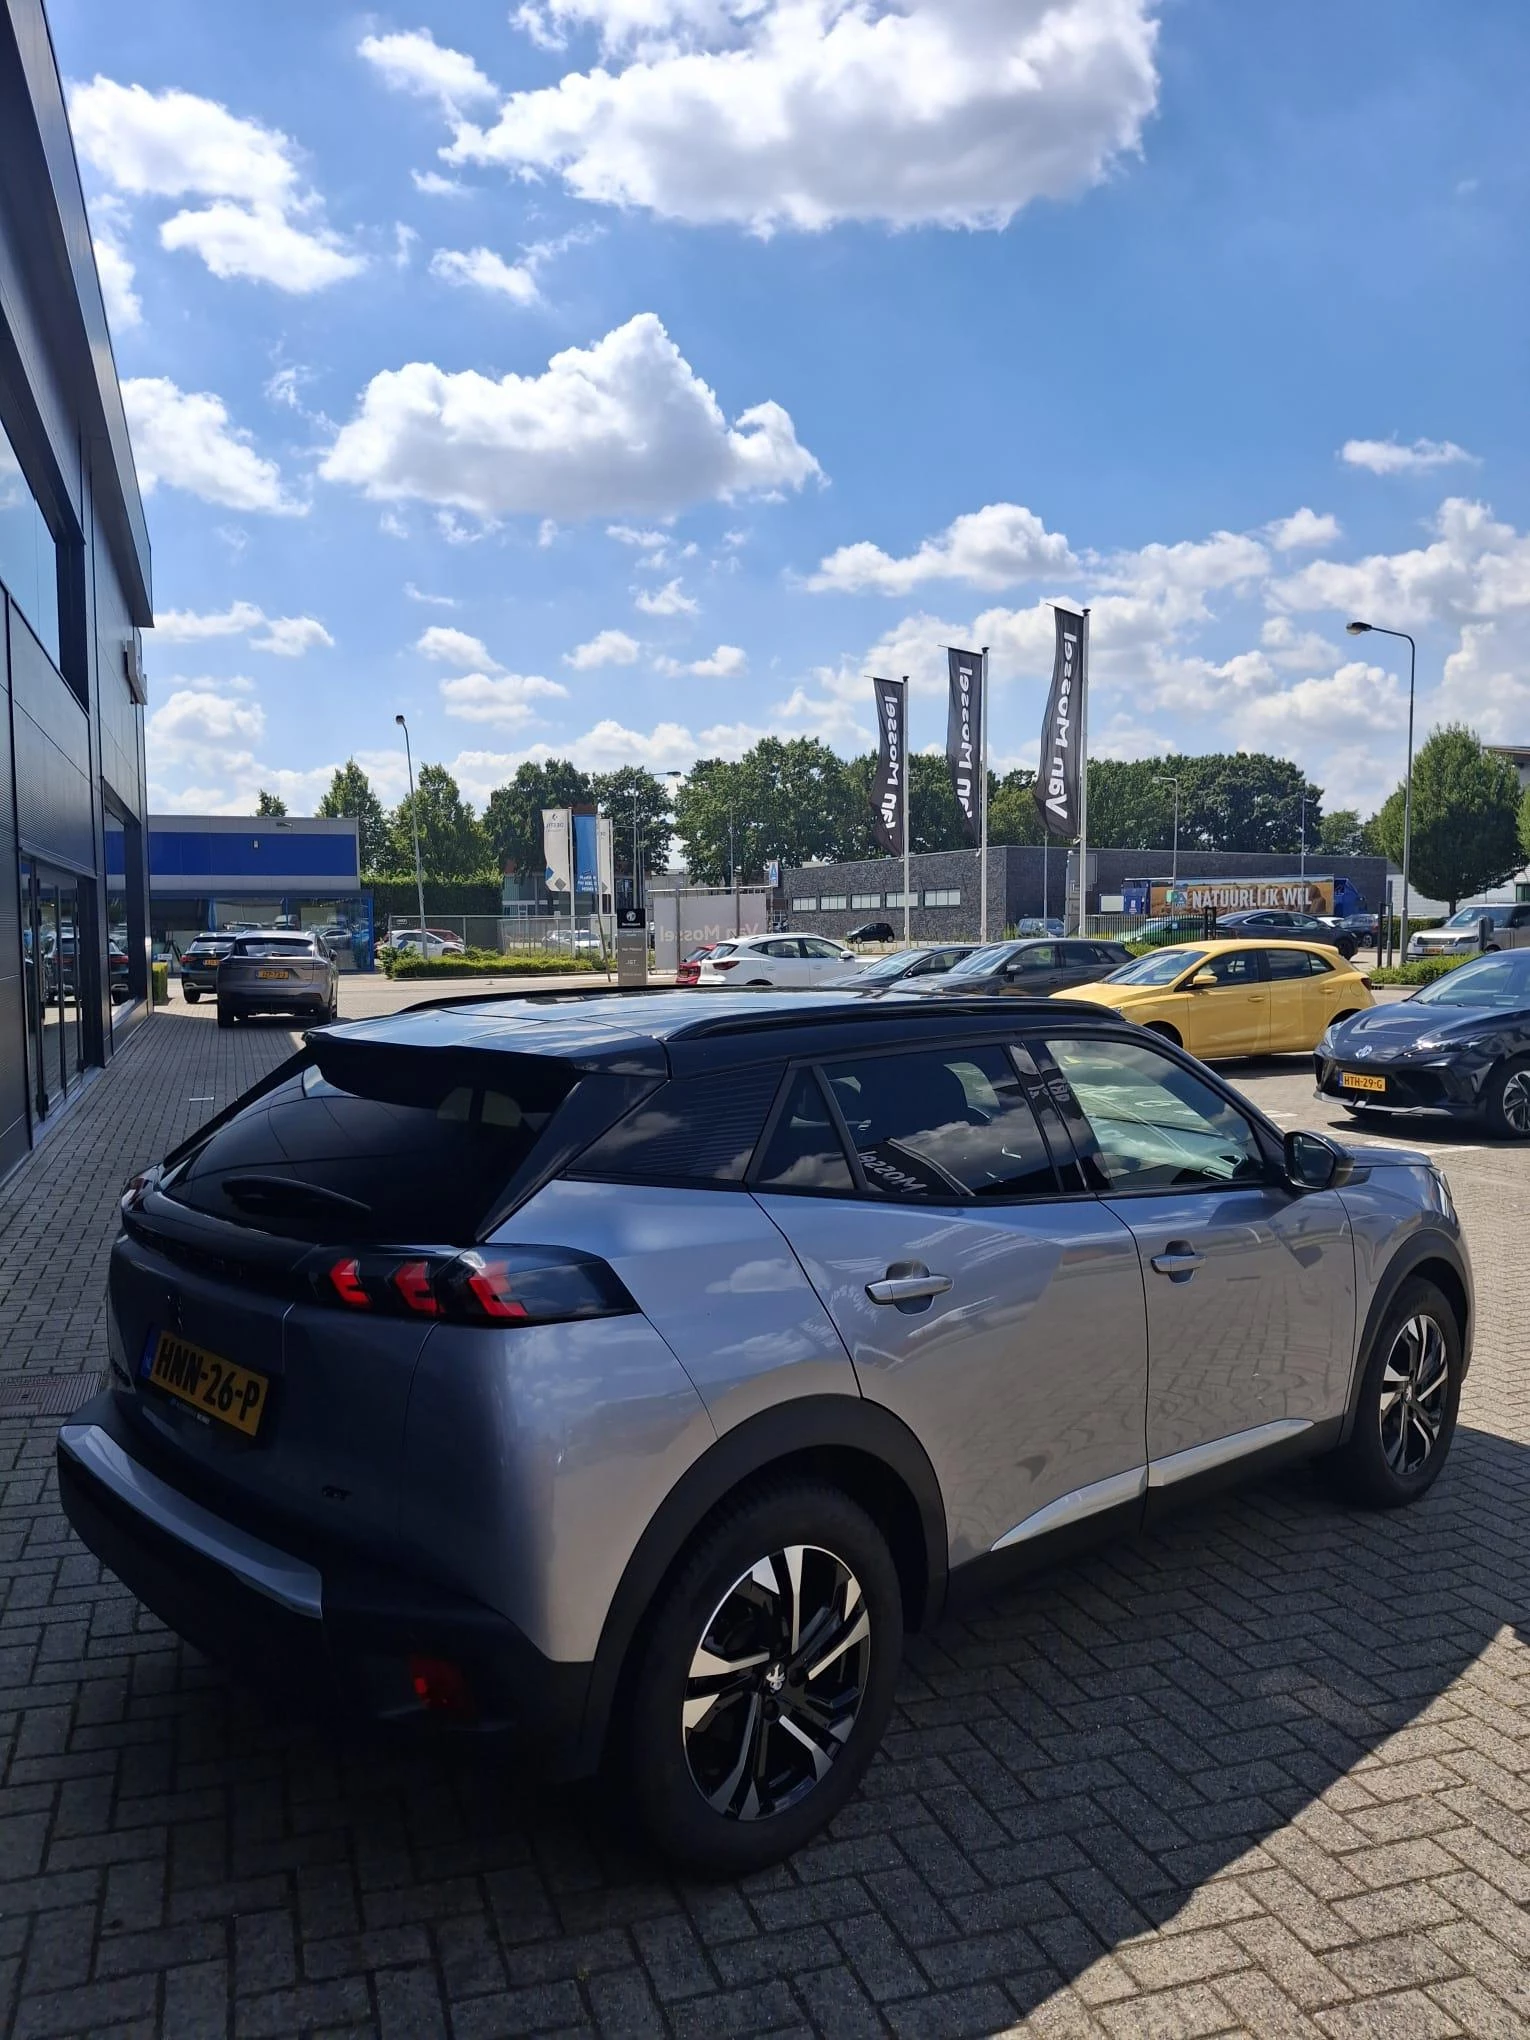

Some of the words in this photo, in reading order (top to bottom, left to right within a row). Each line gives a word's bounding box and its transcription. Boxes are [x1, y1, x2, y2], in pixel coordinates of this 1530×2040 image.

[1192, 888, 1279, 909] NATUURLIJK
[1343, 1074, 1383, 1090] HTH-29-G
[154, 1338, 261, 1422] HNN-26-P
